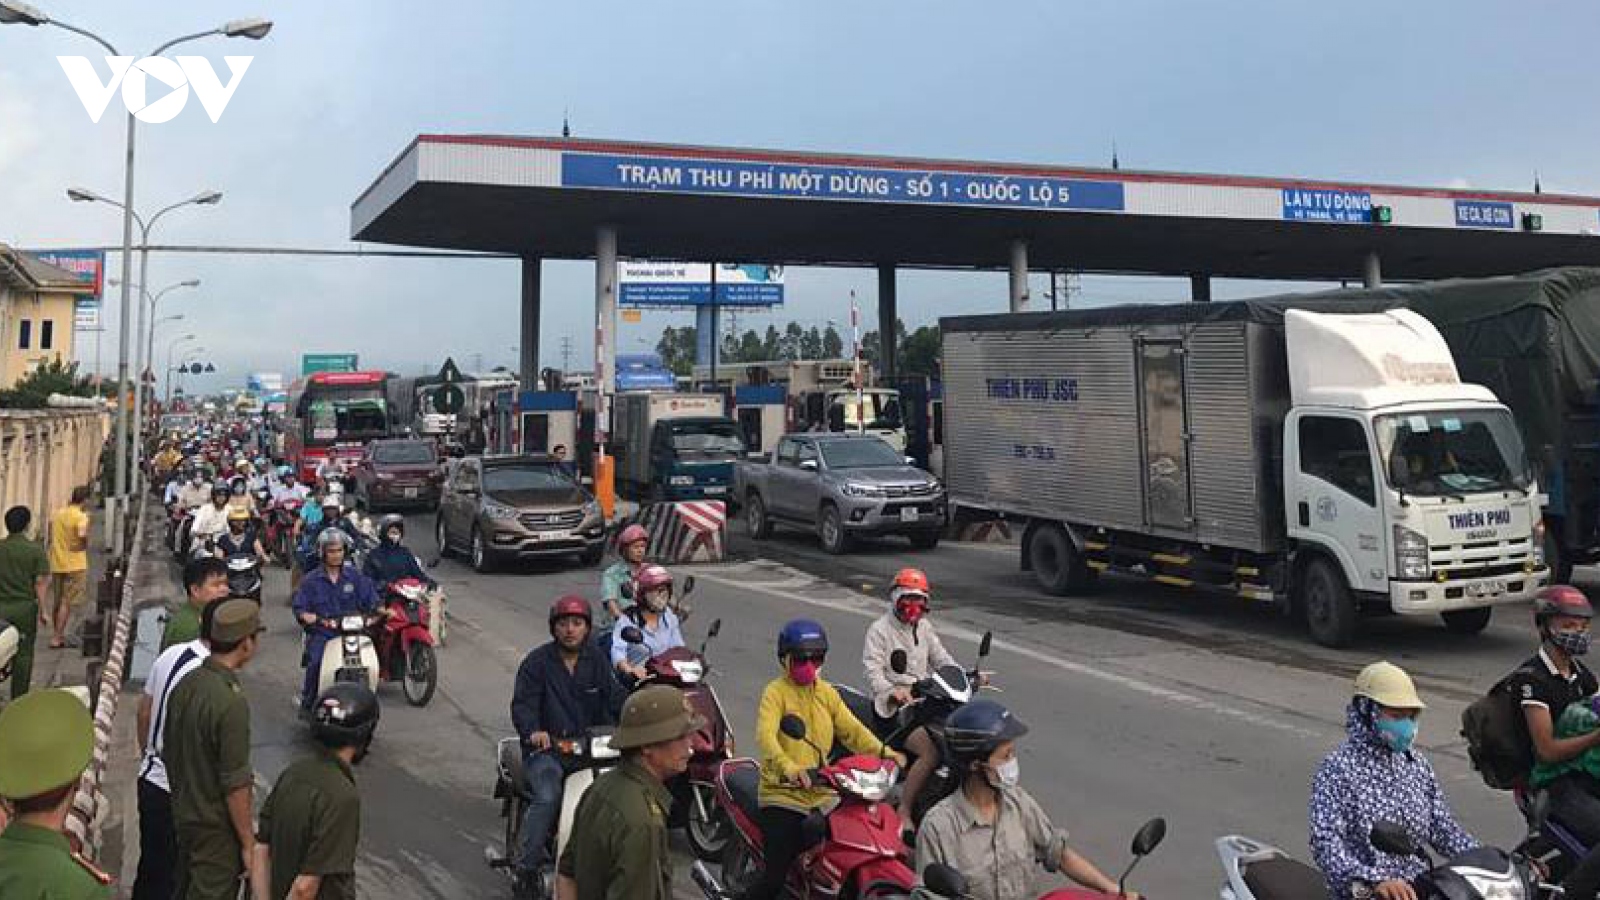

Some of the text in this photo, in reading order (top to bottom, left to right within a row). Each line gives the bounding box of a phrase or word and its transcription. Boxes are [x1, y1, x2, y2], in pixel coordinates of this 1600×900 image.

[617, 164, 682, 189] TRẠM
[688, 167, 731, 187] THU
[739, 166, 774, 189] PHÍ
[779, 170, 824, 194] MỘT
[830, 170, 889, 195] DỪNG
[906, 172, 933, 197] SỐ
[939, 181, 948, 197] 1
[967, 176, 1021, 201] QUỐC
[1029, 181, 1053, 207] LỘ
[1058, 187, 1070, 203] 5
[1447, 509, 1484, 530] THIÊN
